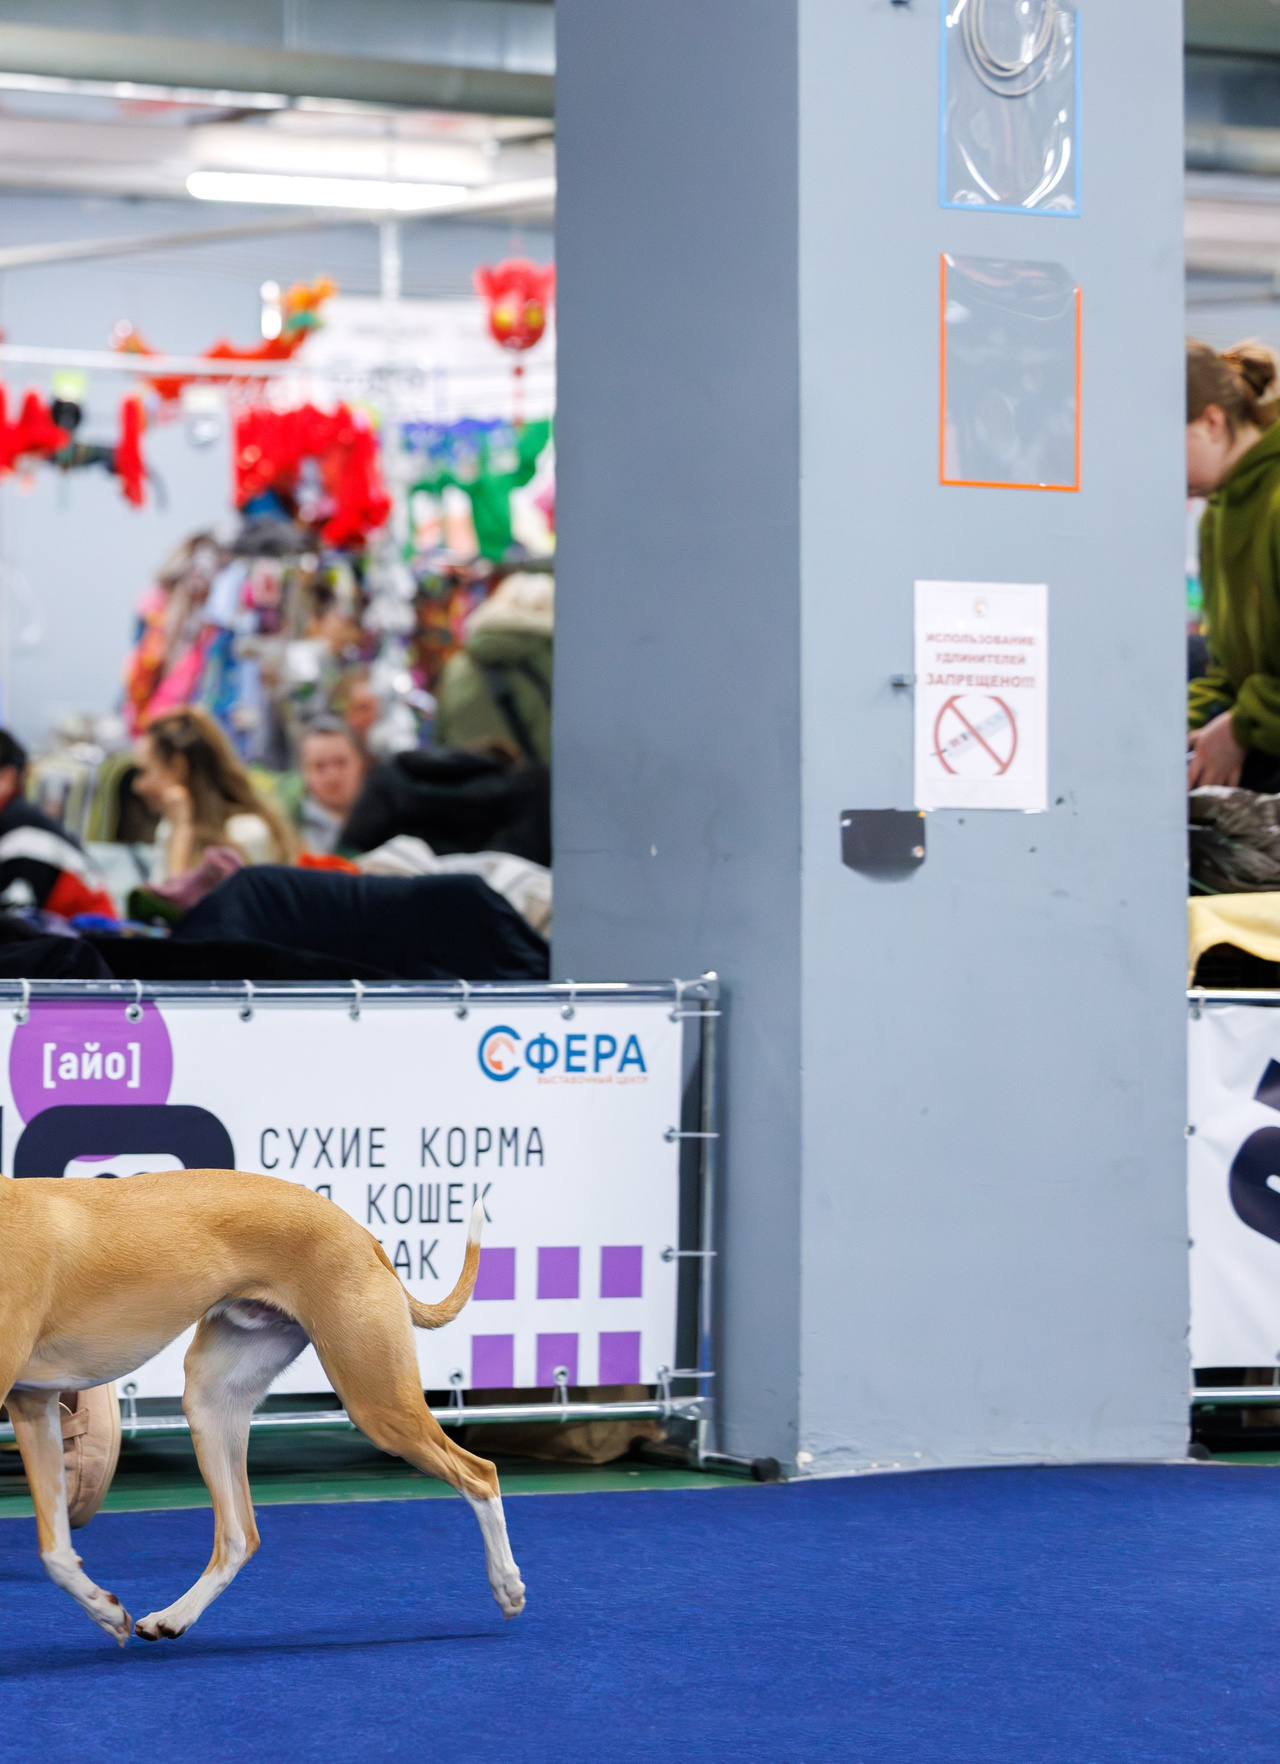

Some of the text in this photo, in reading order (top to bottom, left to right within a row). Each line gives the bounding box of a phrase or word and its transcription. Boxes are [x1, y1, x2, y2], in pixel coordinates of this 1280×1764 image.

[926, 633, 1035, 646] ИСПОЛЬЗОВАНИЕ
[935, 652, 1026, 665] УДЛИНИТЕЛЕЙ
[42, 1042, 141, 1089] [айо]
[478, 1025, 647, 1082] СФЕРА
[260, 1127, 386, 1169] СУХИЕ
[421, 1126, 545, 1168] КОРМА
[367, 1182, 493, 1224] КОШЕК
[377, 1239, 439, 1280] АК
